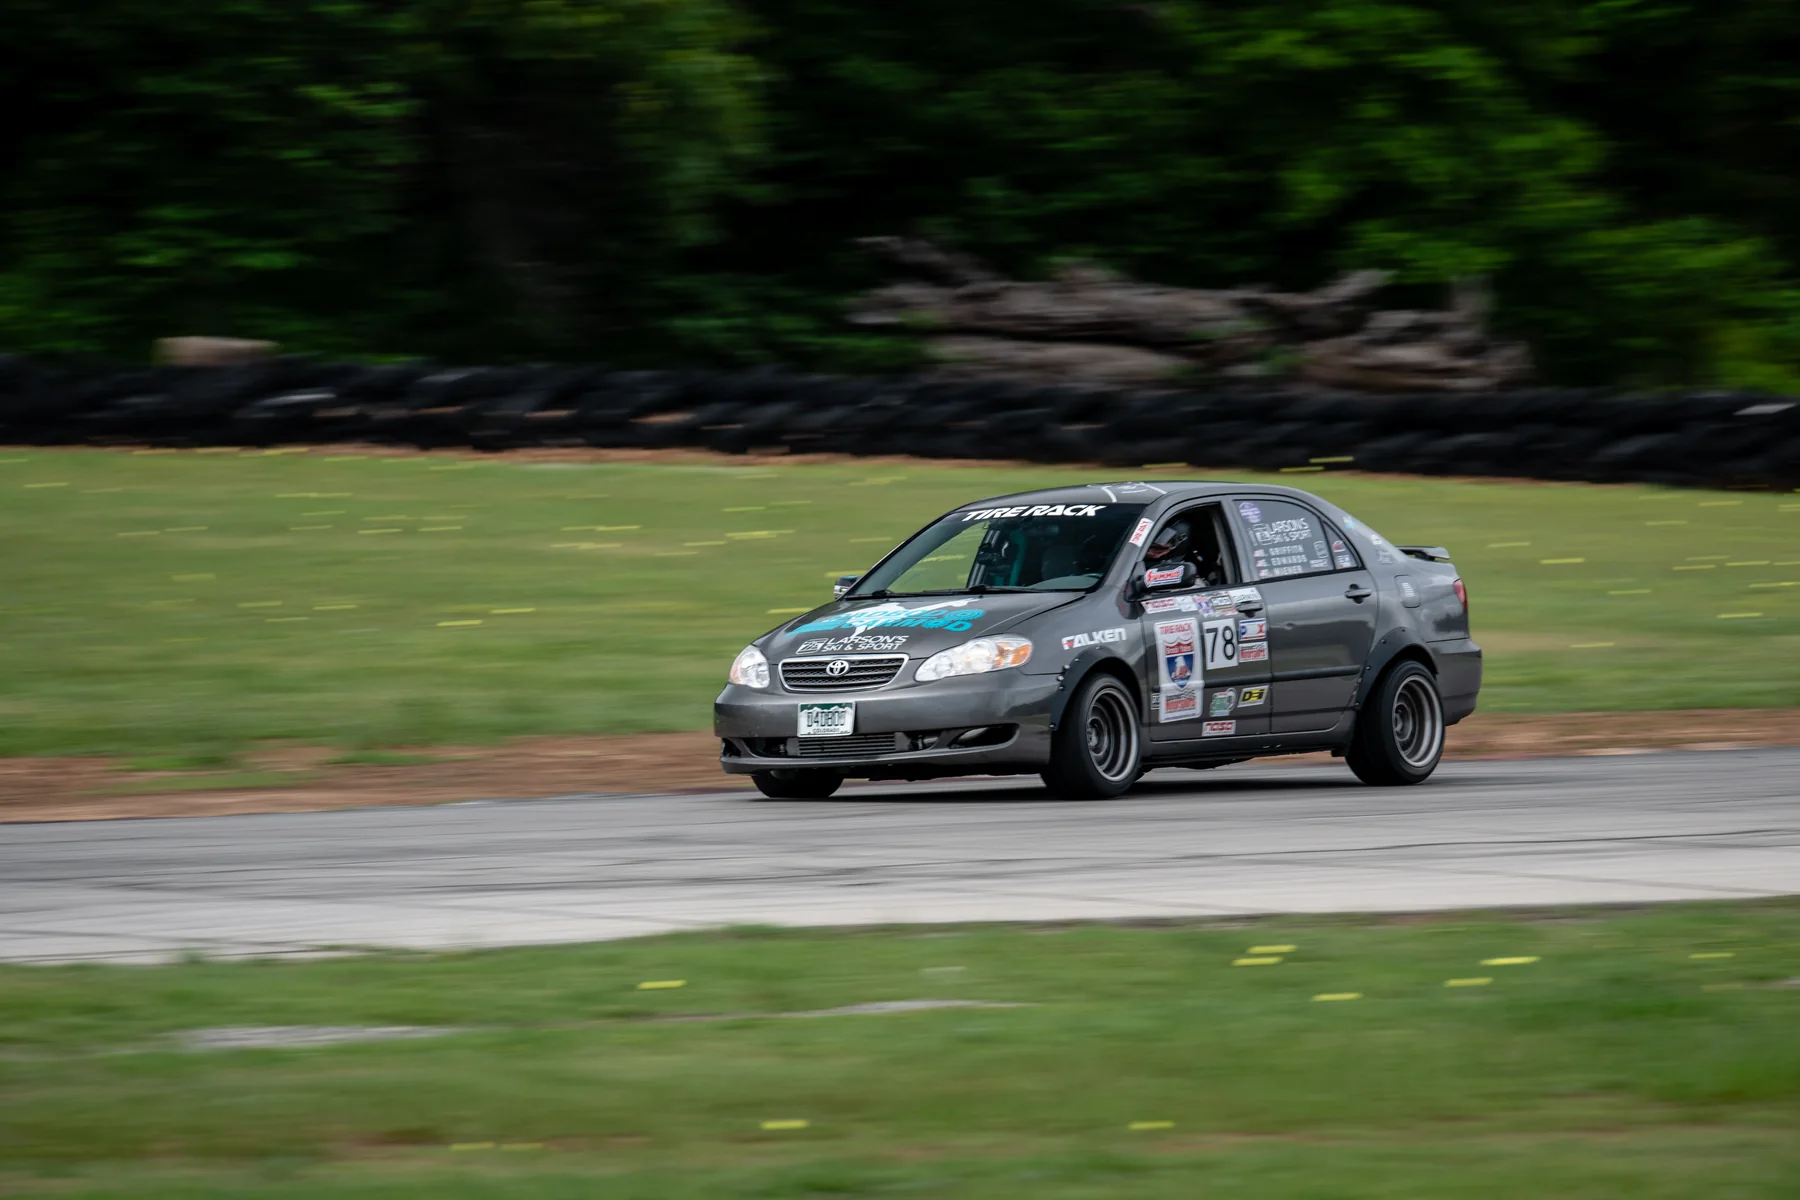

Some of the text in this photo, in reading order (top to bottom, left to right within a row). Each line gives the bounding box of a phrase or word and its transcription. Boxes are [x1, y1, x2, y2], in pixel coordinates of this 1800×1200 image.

[962, 504, 1107, 521] TIRE RACK
[822, 644, 843, 652] SKI
[858, 643, 901, 651] SPORT
[827, 635, 909, 644] LARSON'S
[1061, 628, 1127, 650] FALKEN
[1205, 626, 1235, 662] 78
